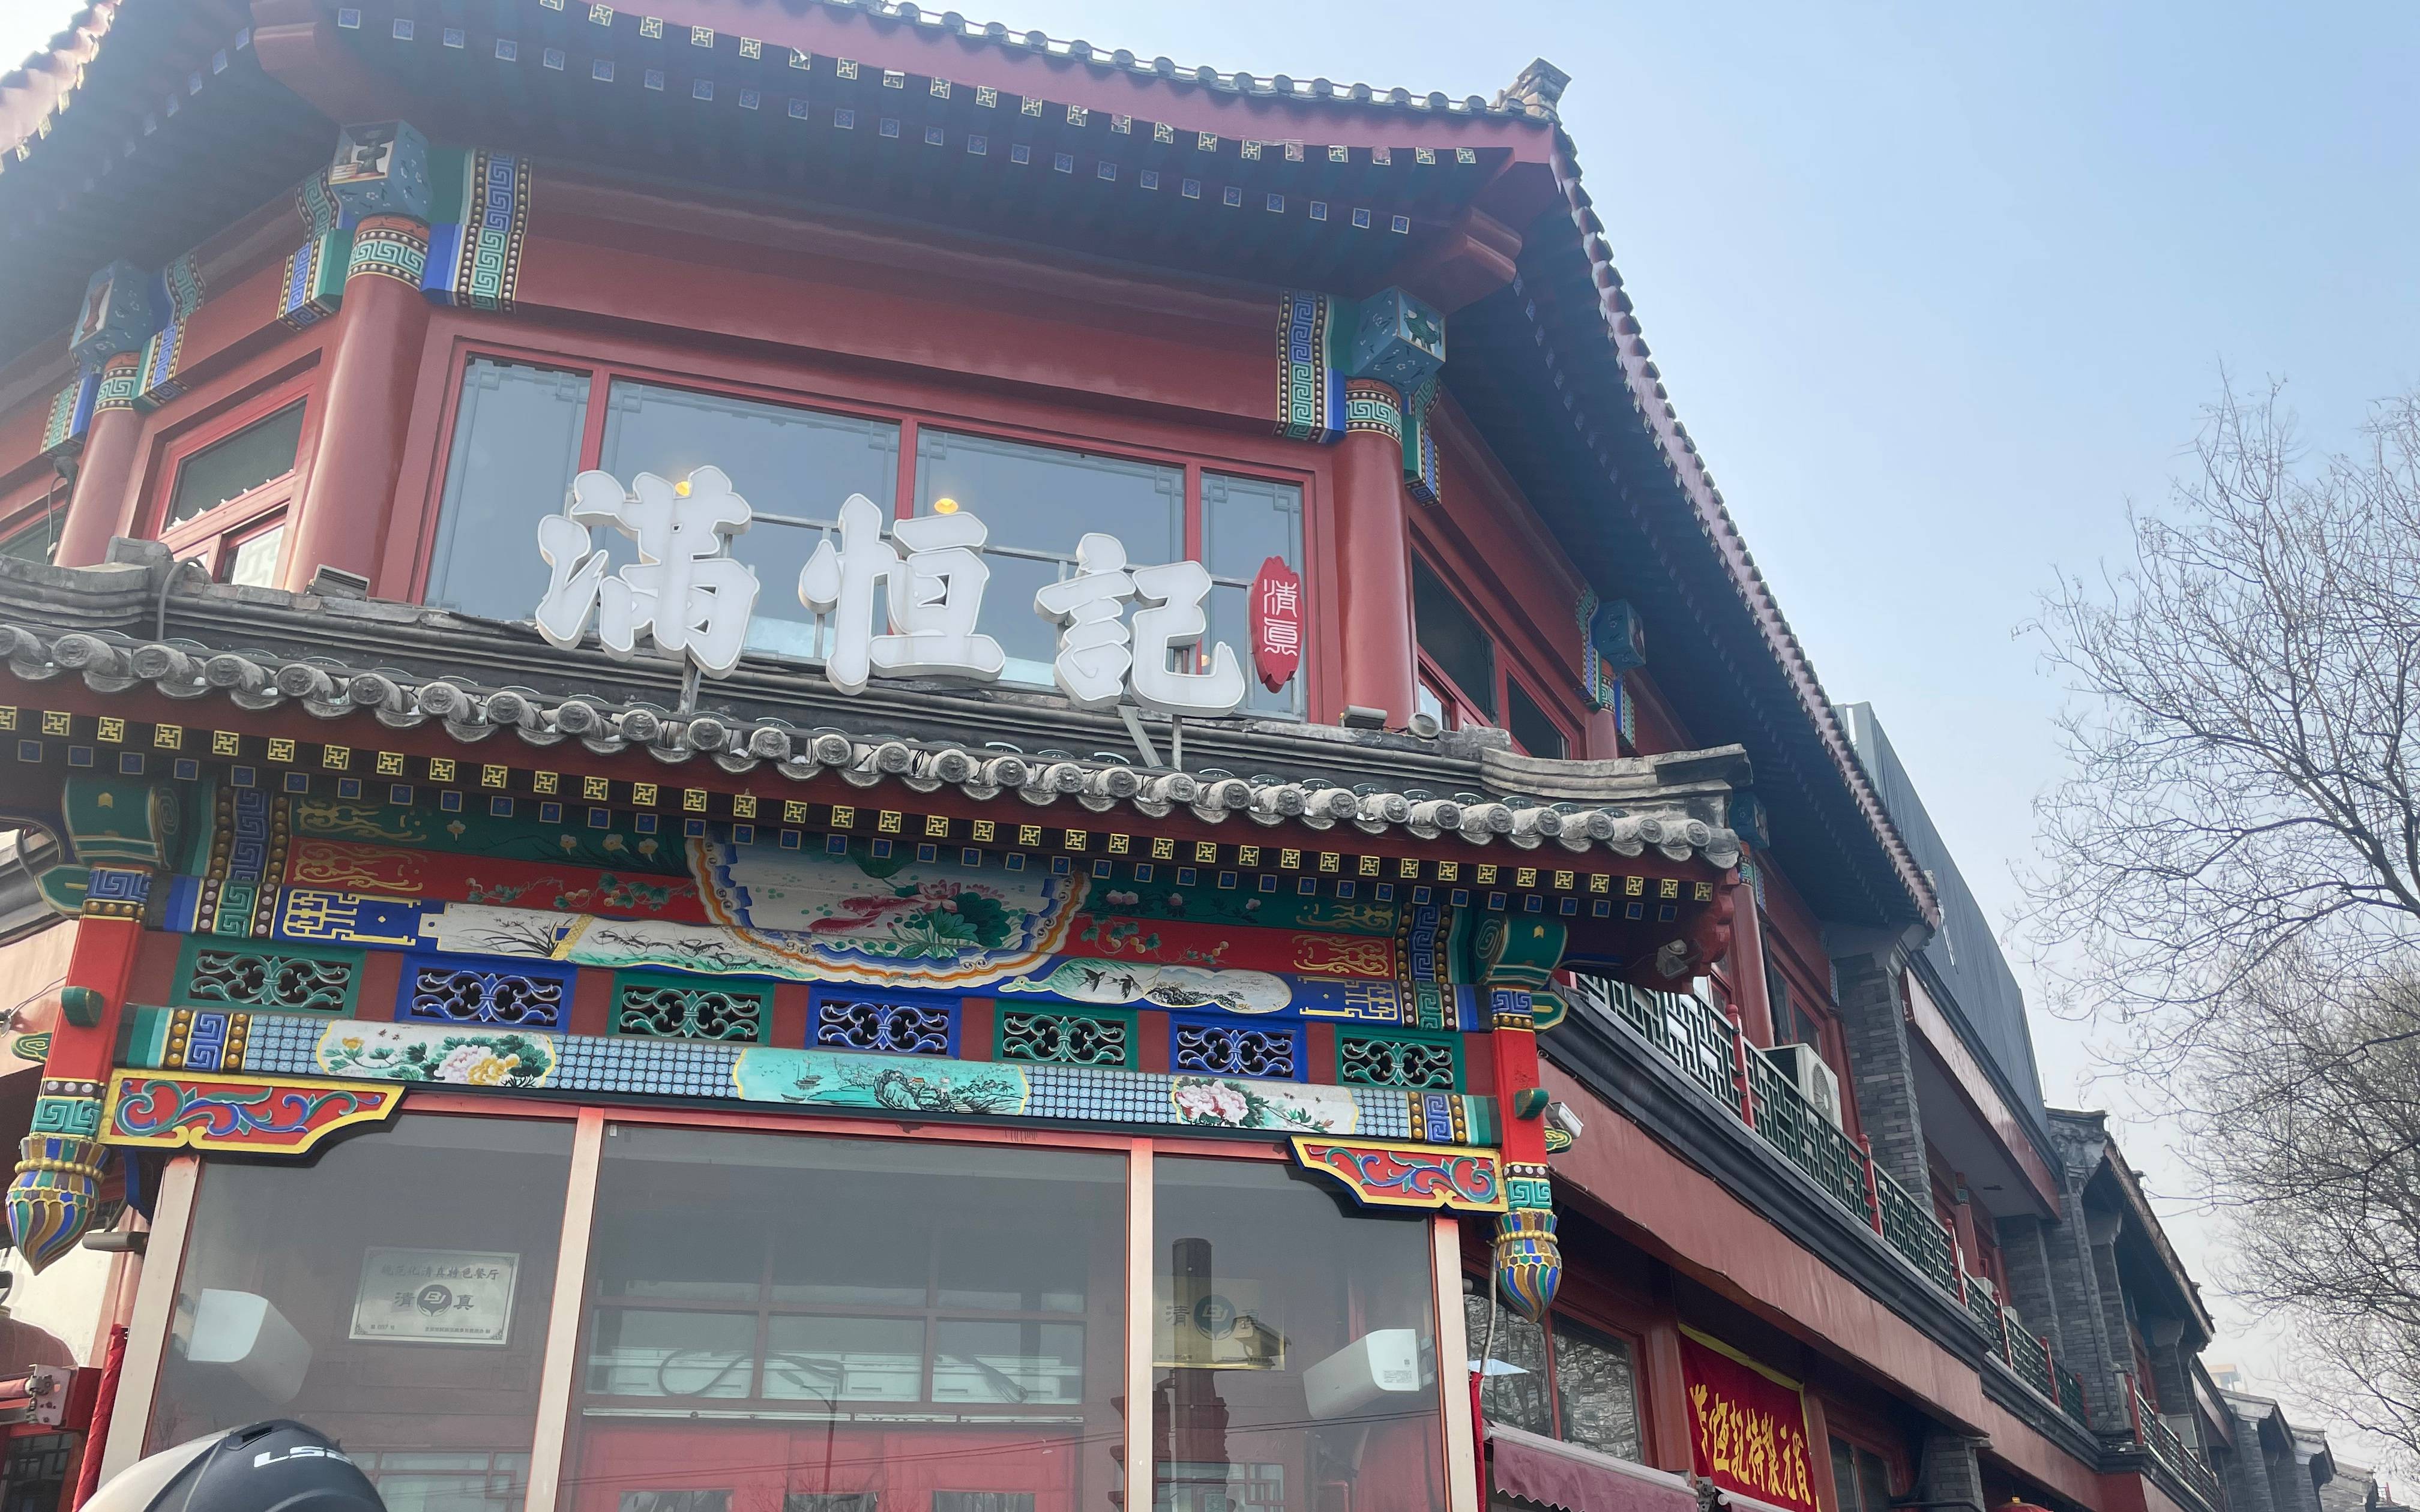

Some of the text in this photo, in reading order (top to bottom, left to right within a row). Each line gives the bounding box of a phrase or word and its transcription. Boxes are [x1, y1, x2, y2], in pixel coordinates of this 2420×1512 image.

[381, 1265, 500, 1280] 规范化清真特色餐厅
[453, 1294, 475, 1310] 真
